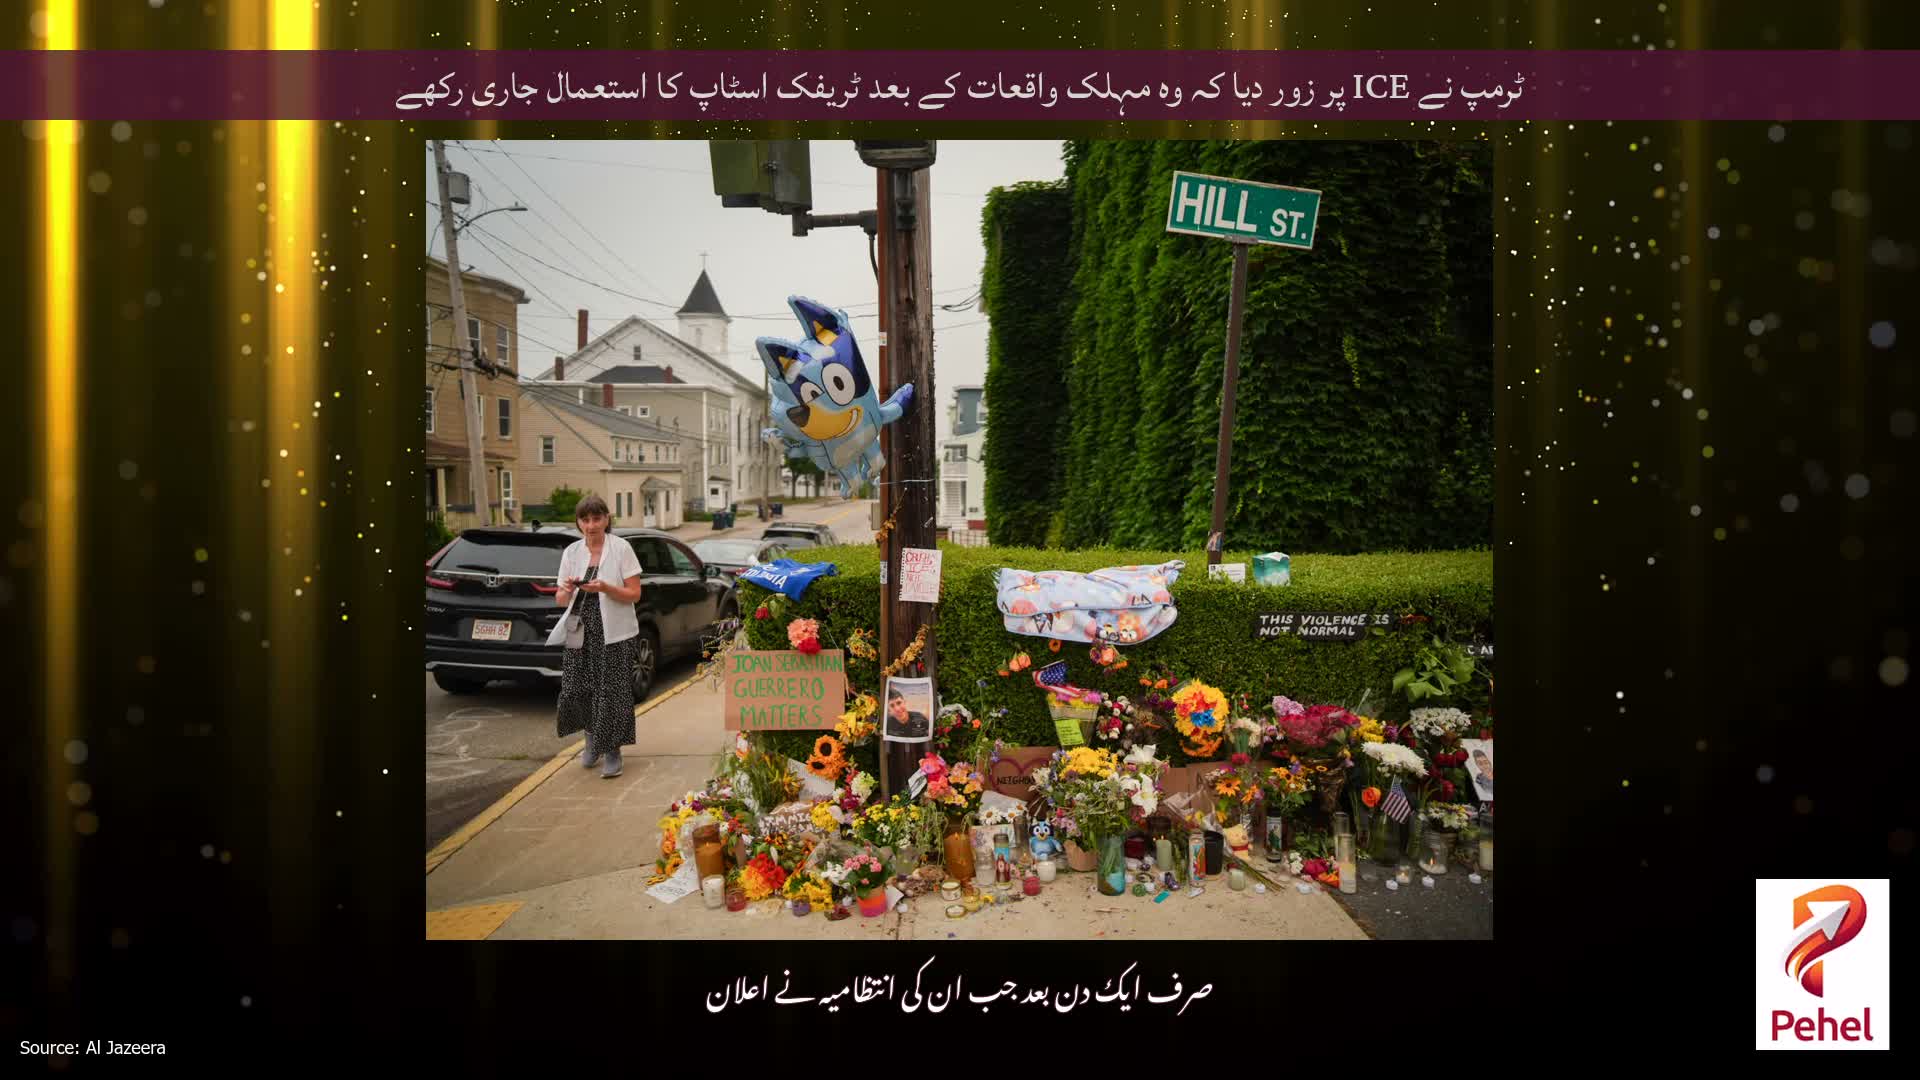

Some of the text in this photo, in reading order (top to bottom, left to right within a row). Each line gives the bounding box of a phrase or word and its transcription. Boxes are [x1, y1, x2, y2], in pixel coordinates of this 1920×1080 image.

[1176, 181, 1306, 240] HILL ST.
[1260, 614, 1390, 626] THIS VIOLENCE IS
[1260, 626, 1356, 637] NOT NORMAL
[732, 653, 843, 673] JOAN SEBASTIAN
[734, 677, 825, 701] GUERRERO
[740, 704, 823, 729] MATTERS
